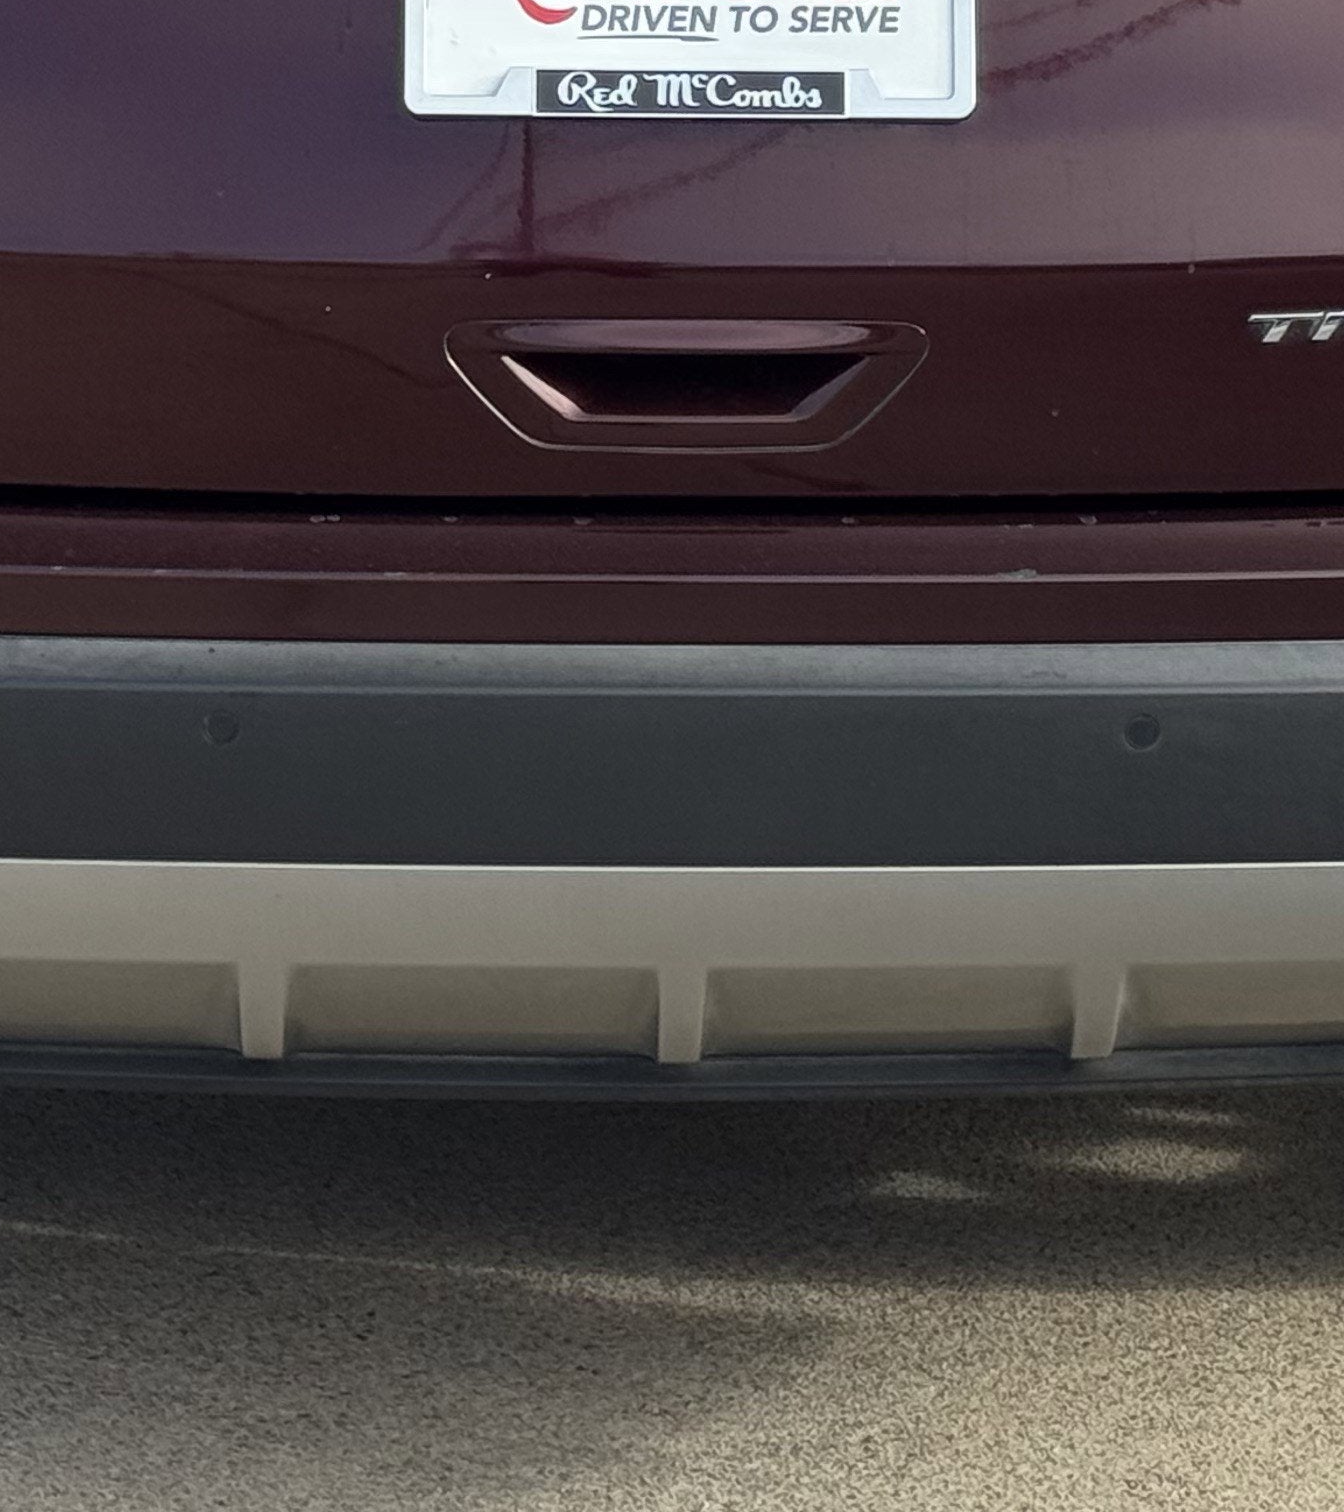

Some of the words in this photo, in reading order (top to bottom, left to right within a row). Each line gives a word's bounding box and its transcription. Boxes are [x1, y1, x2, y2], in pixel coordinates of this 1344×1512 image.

[581, 4, 718, 33] DRIVEN
[730, 5, 779, 34] TO
[788, 5, 901, 35] SERVE
[557, 71, 638, 112] Red
[642, 72, 822, 110] McCombs
